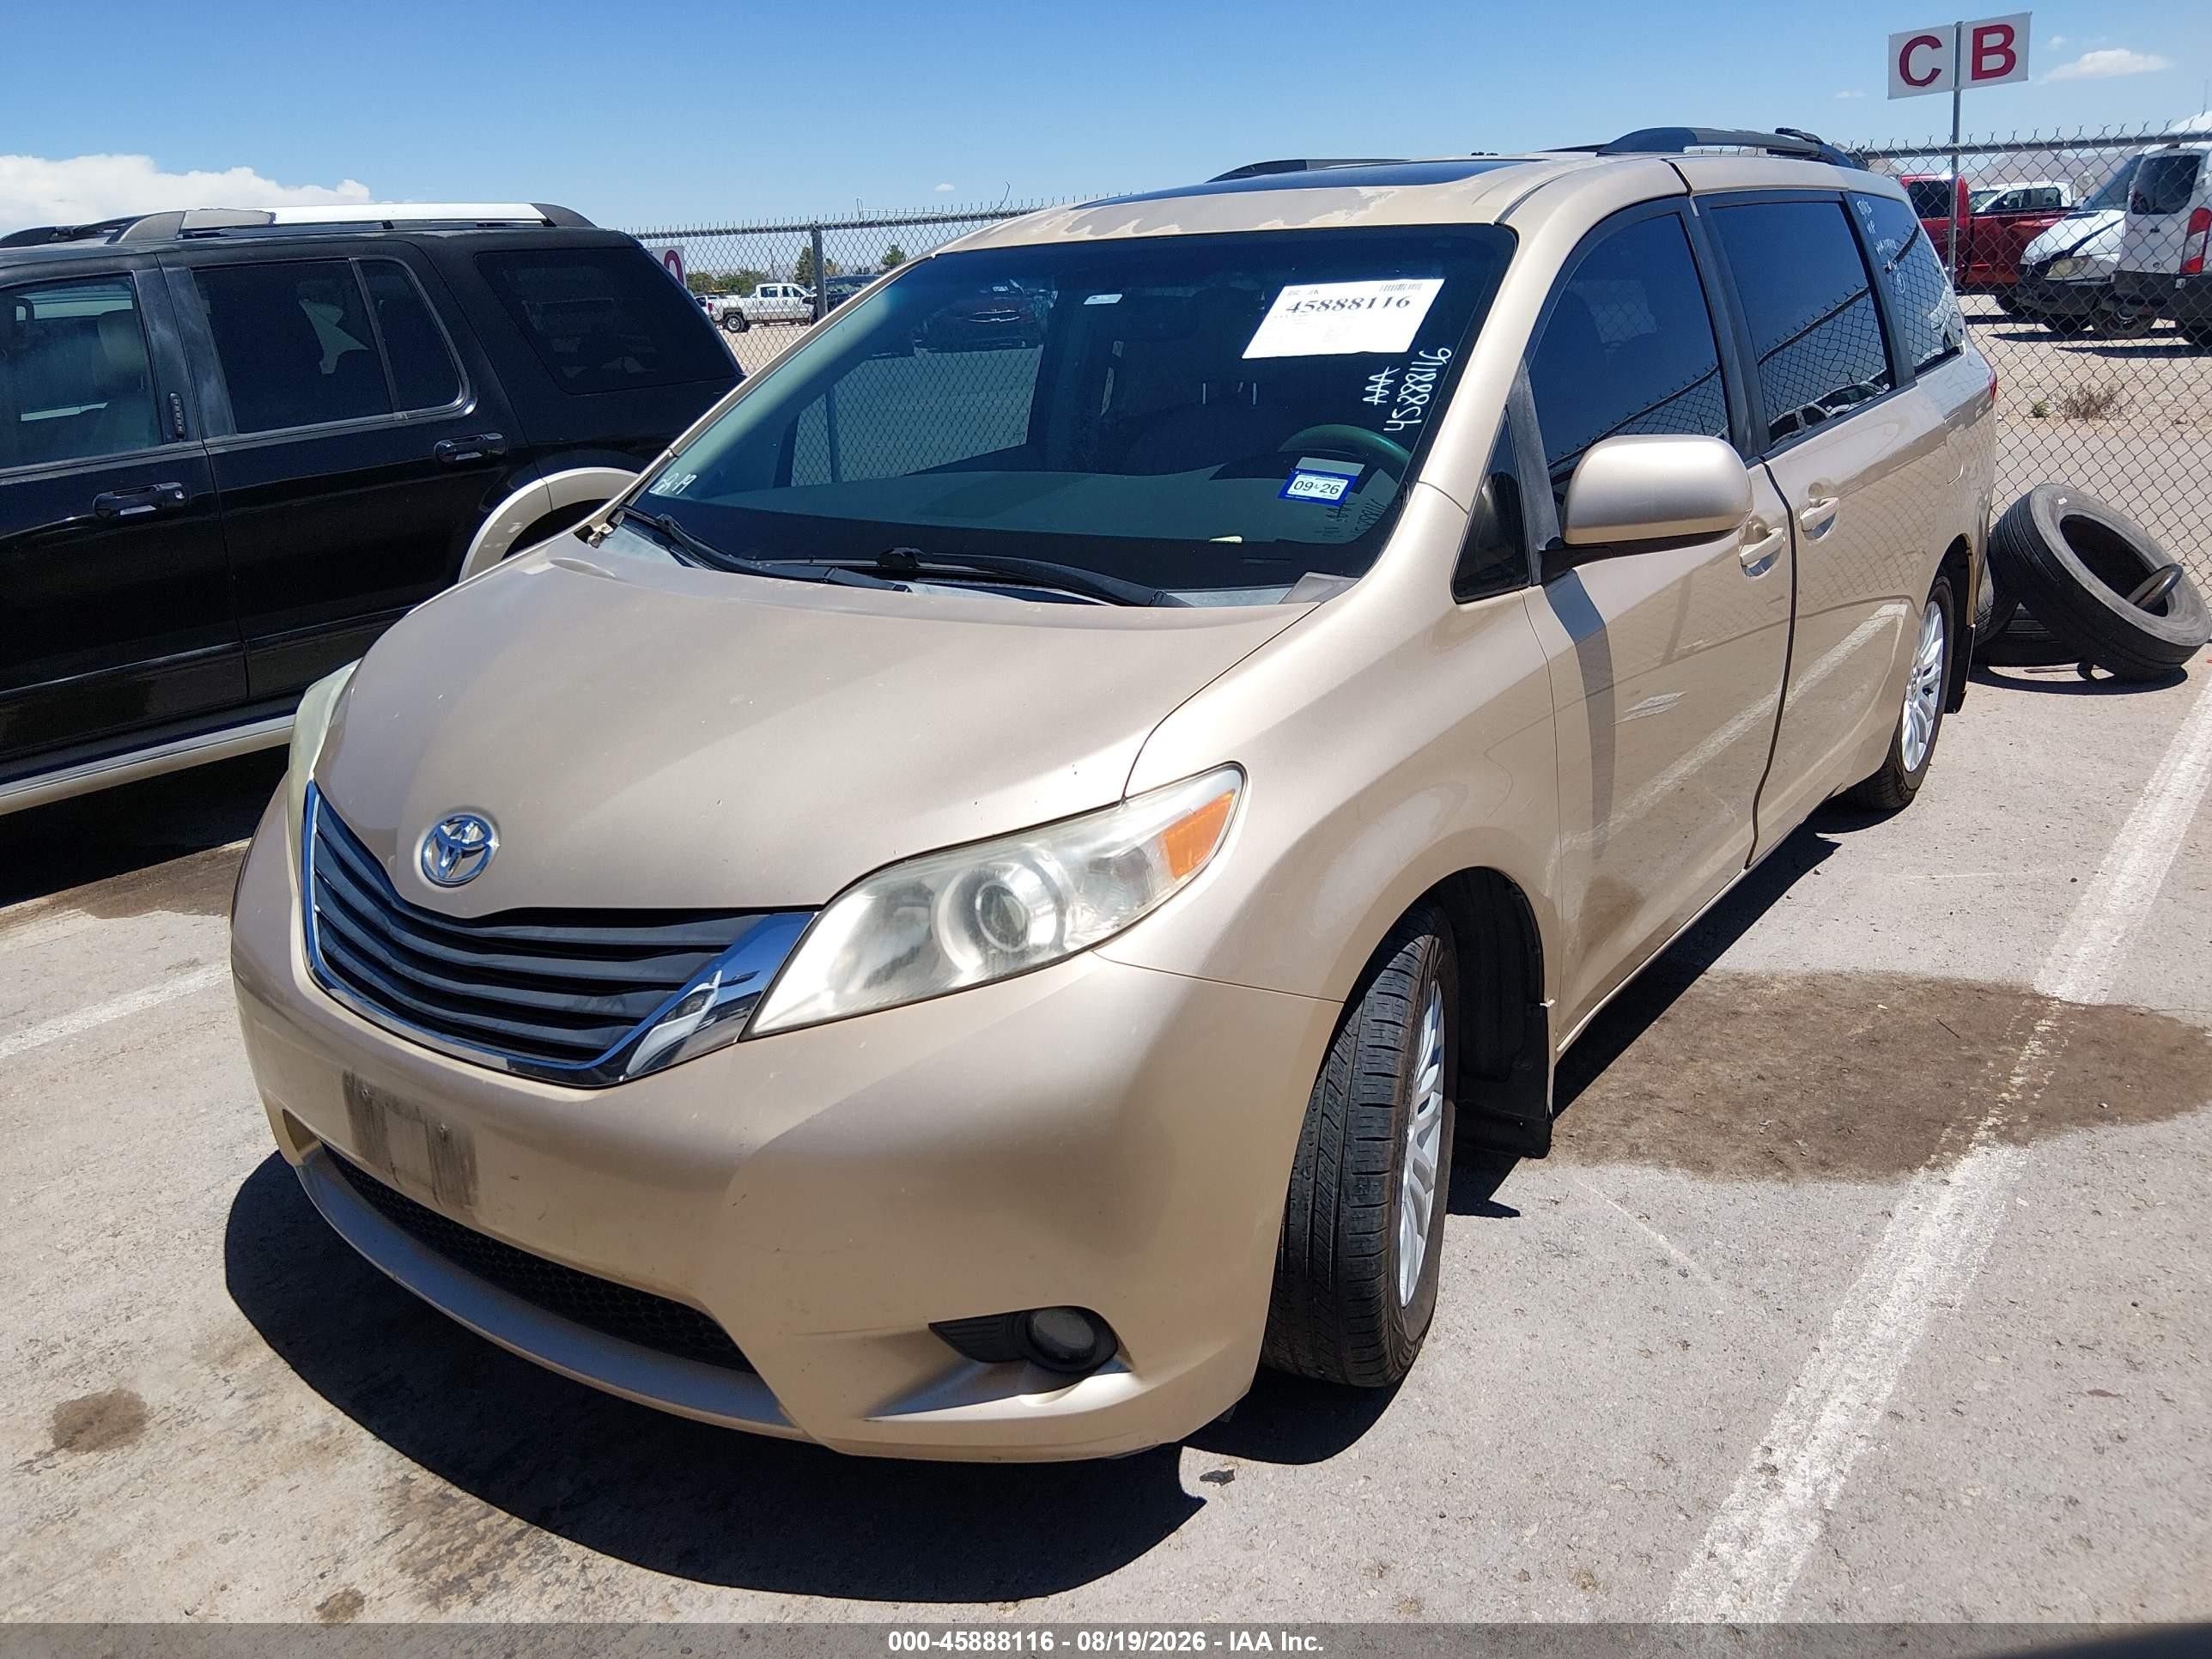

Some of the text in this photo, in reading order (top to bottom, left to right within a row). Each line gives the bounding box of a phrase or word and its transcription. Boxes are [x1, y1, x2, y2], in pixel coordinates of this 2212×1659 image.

[1899, 35, 1942, 87] C
[1971, 24, 2016, 82] B
[1285, 295, 1411, 313] 45888116
[1383, 348, 1452, 431] 45888116
[1293, 480, 1314, 491] 09
[1319, 483, 1340, 495] 26
